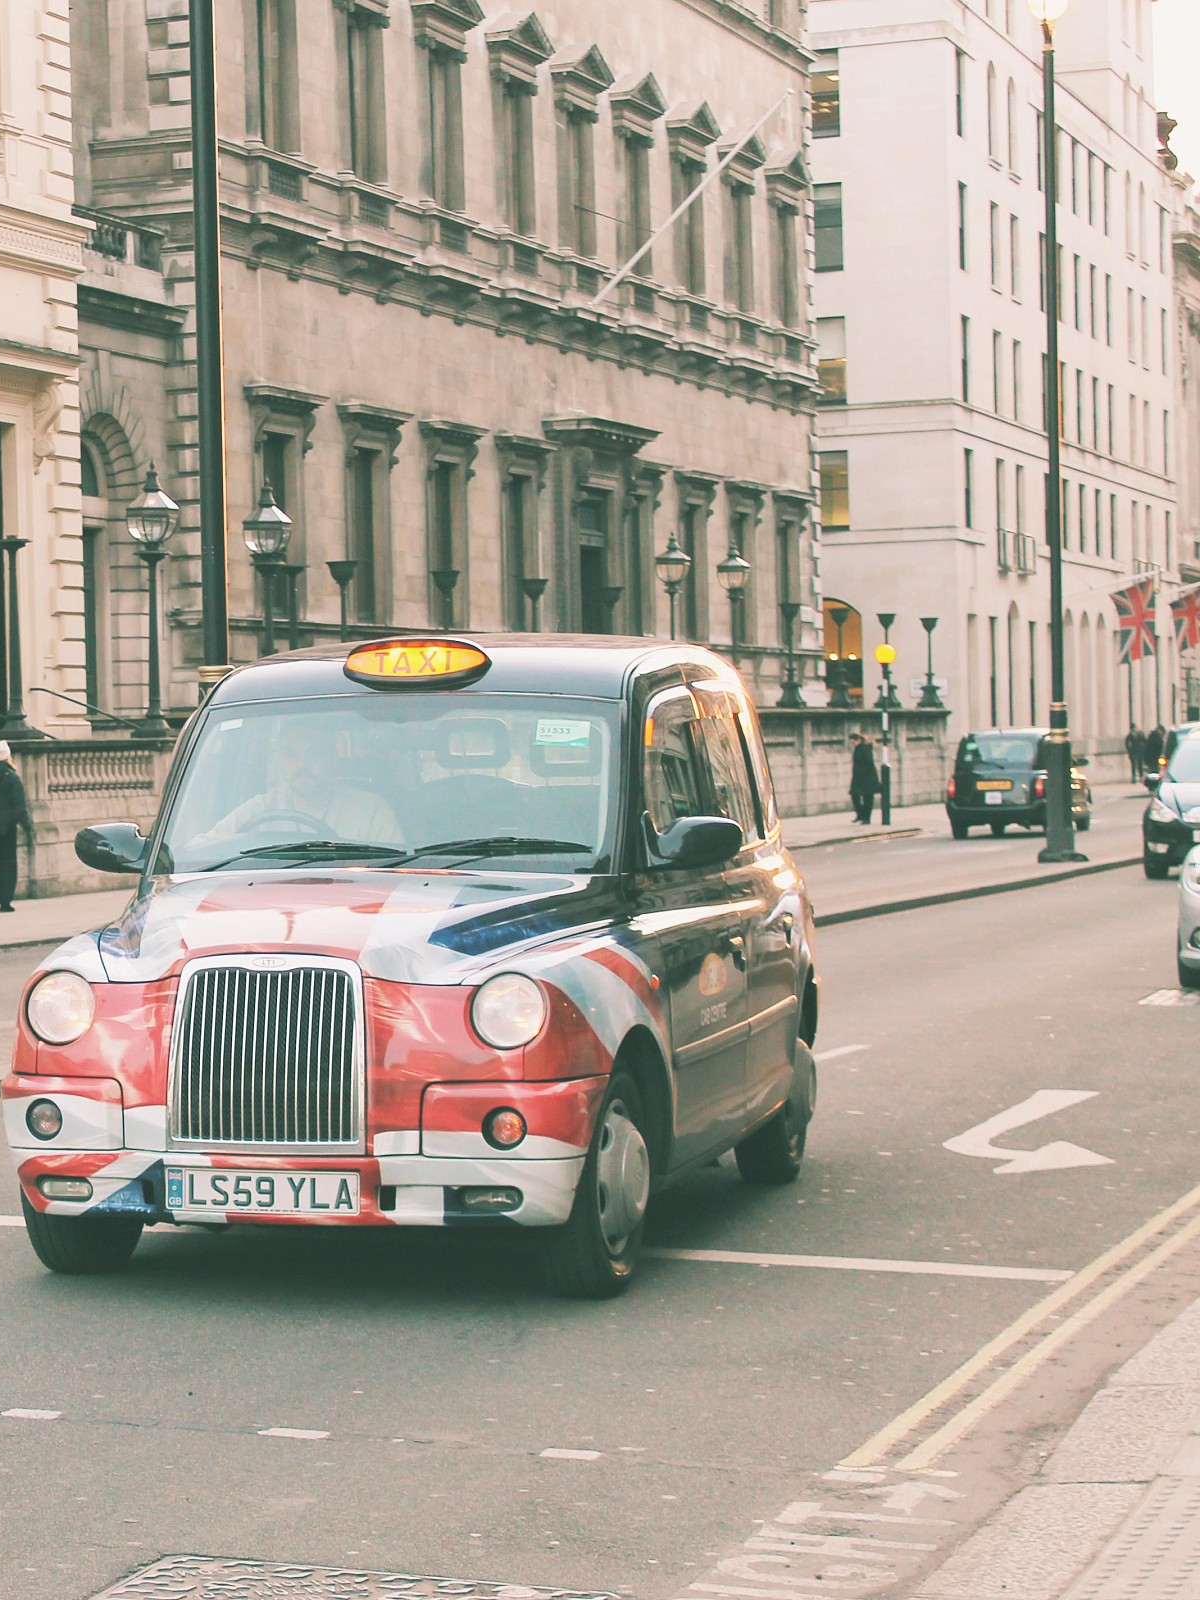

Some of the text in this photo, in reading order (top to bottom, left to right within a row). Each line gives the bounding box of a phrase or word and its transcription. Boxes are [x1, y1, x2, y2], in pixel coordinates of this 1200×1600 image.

[374, 650, 452, 674] TAXI
[168, 1196, 182, 1206] GB
[188, 1173, 354, 1210] LS59 YLA
